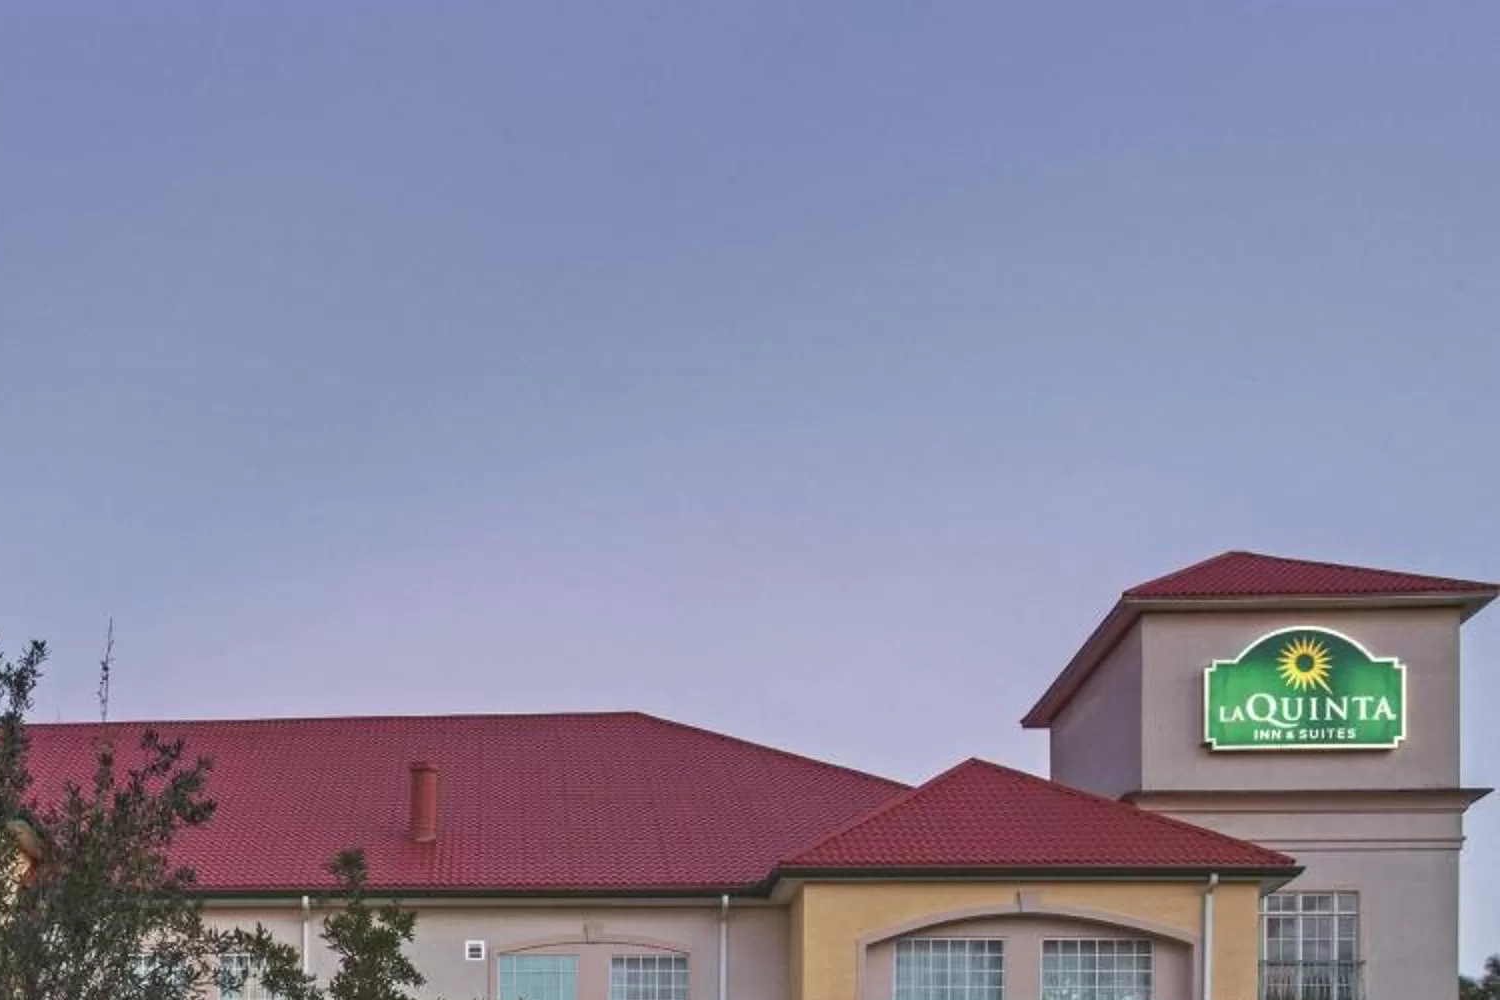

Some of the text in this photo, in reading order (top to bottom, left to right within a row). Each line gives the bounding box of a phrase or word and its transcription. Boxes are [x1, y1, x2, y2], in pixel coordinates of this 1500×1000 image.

[1246, 693, 1397, 728] QUINTA
[1254, 728, 1357, 741] INN & SUITES
